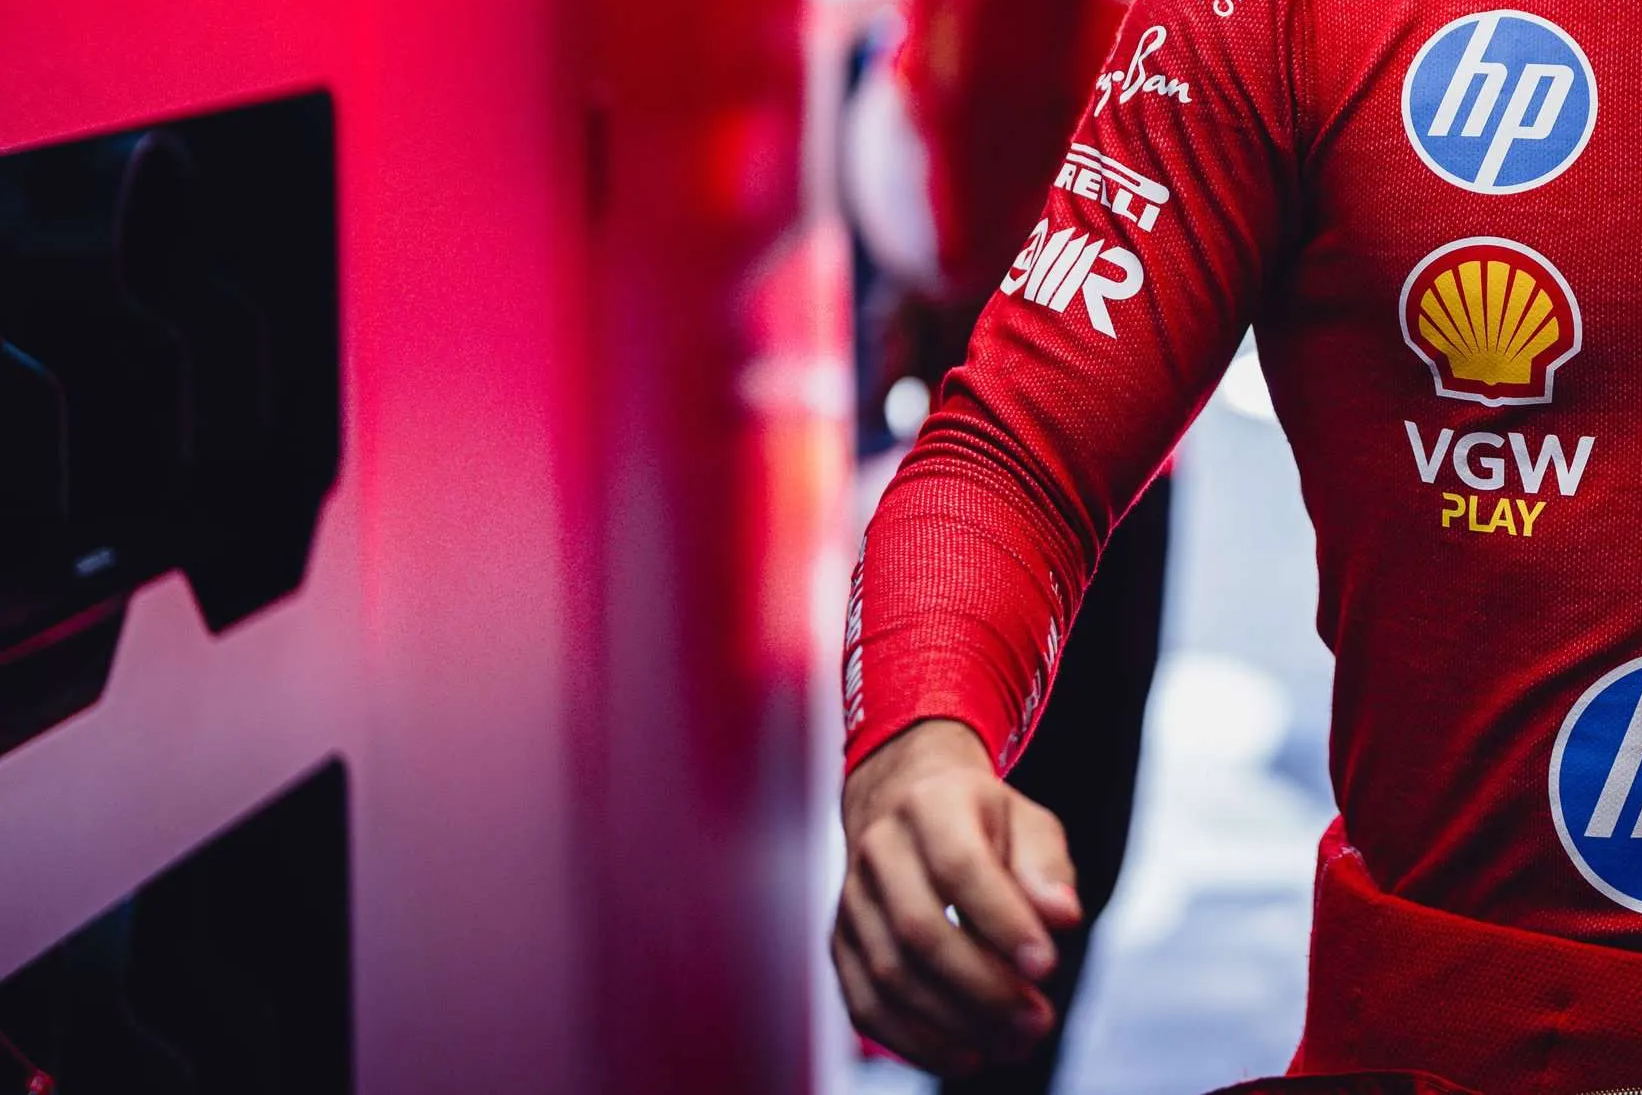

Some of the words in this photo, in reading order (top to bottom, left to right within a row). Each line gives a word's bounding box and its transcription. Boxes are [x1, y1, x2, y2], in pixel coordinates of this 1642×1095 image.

[1427, 12, 1575, 190] hp
[1404, 420, 1597, 496] VGW
[1441, 492, 1548, 537] PLAY
